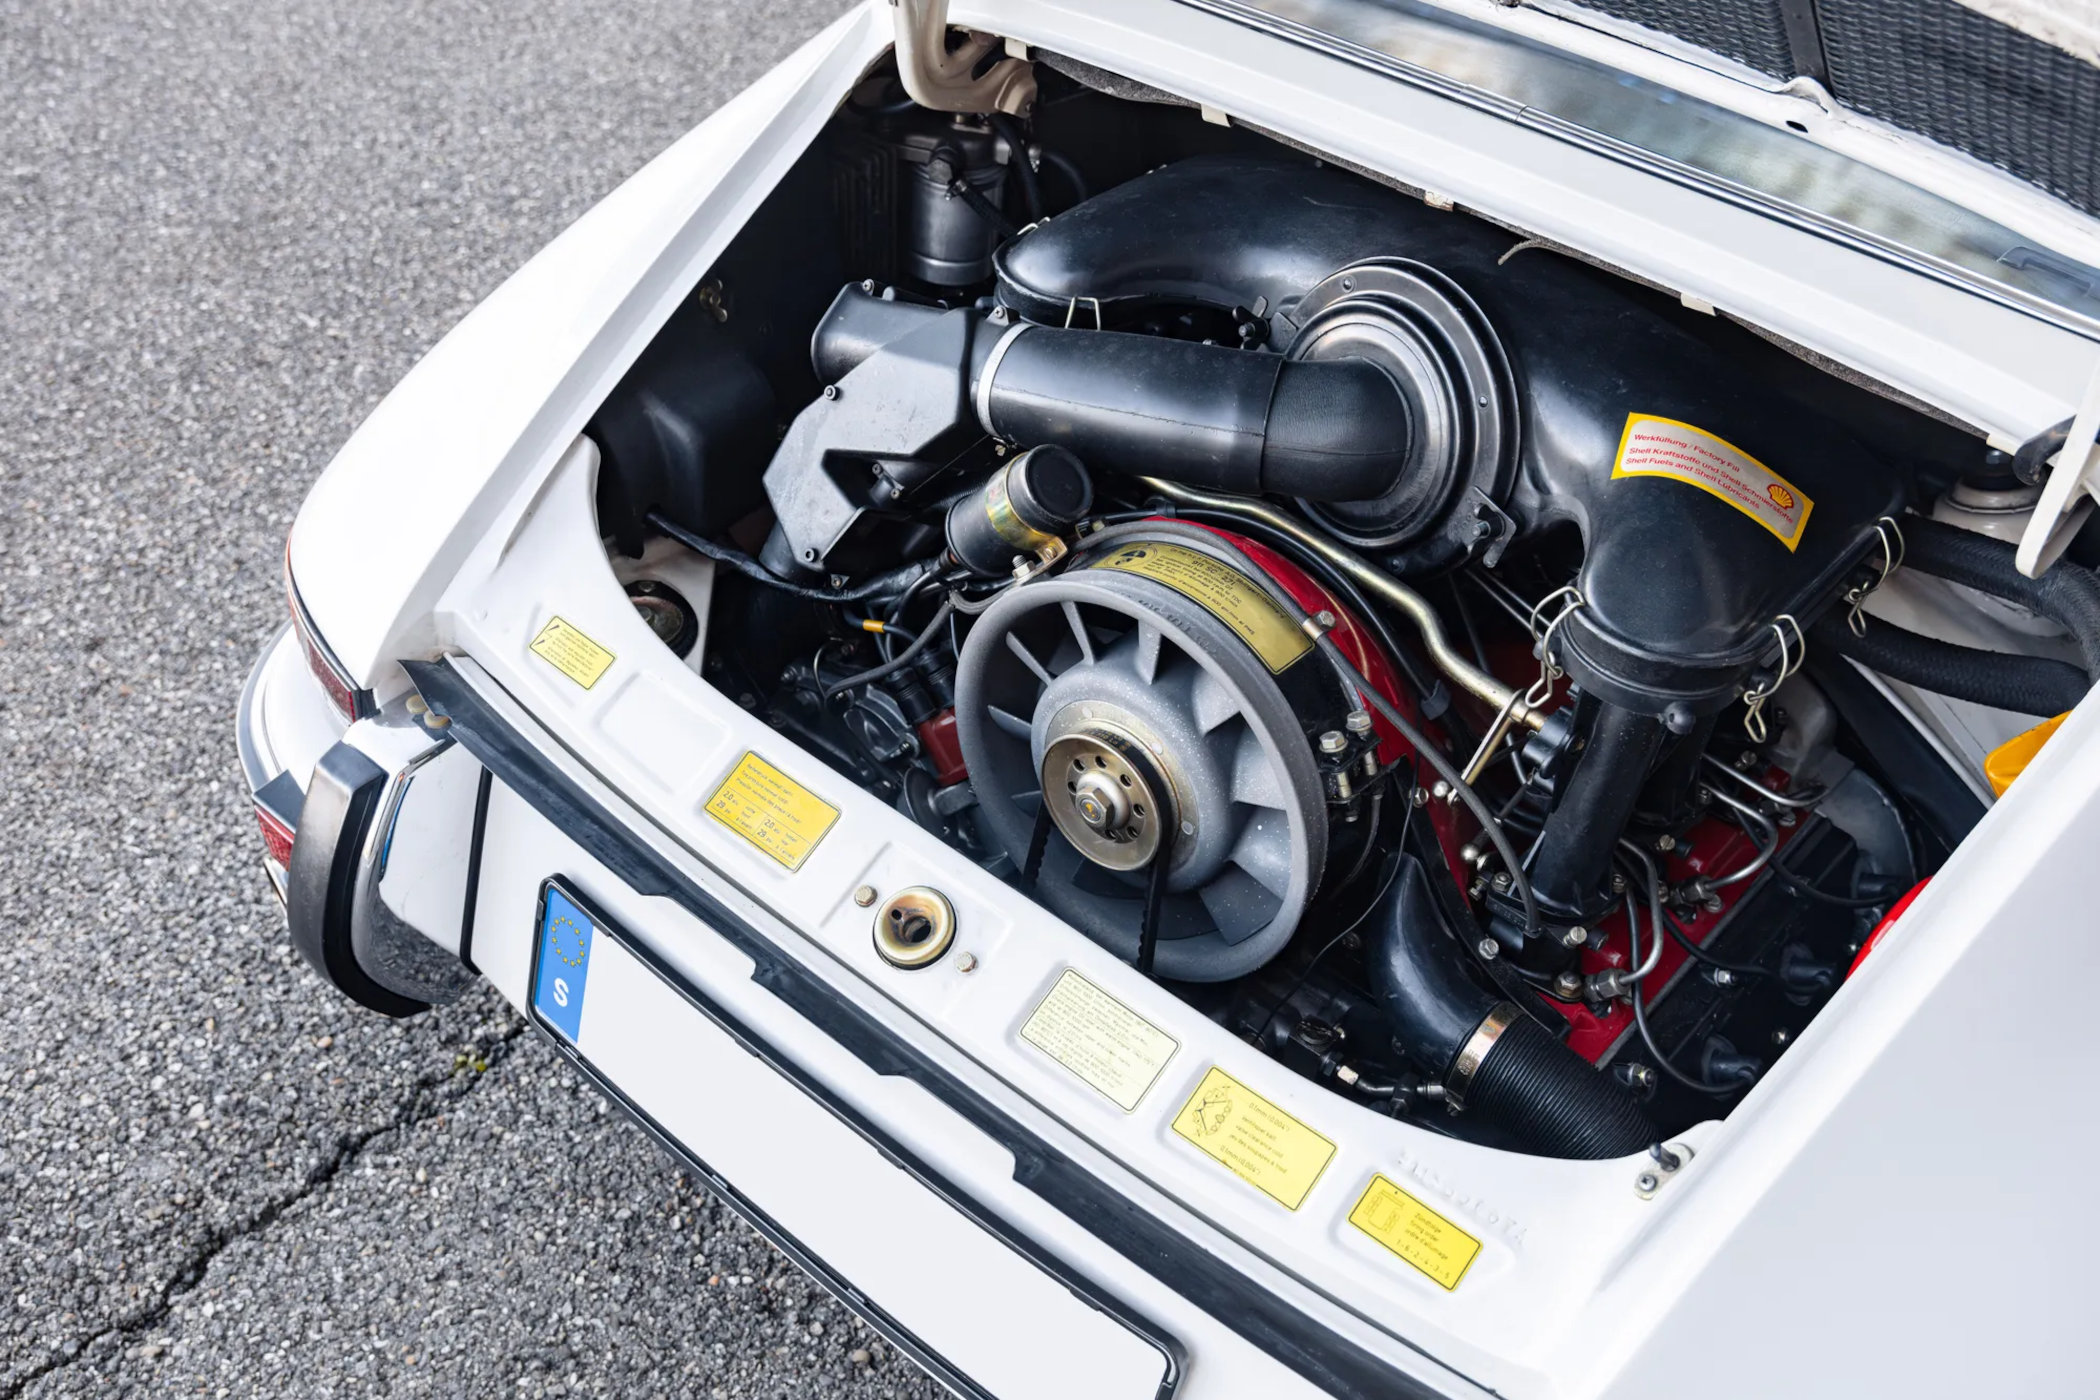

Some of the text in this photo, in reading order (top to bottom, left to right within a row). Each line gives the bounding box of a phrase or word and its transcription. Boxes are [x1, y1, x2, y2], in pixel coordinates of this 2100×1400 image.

[1634, 434, 1688, 449] Werkfüllung
[1693, 445, 1726, 464] Factory
[1727, 461, 1740, 472] Fill
[1626, 457, 1760, 509] Shell Fuels and Shell Lubricants
[1629, 447, 1794, 523] Shell Kraftstoffe und Shell Schmierstoffe
[553, 977, 569, 1008] S
